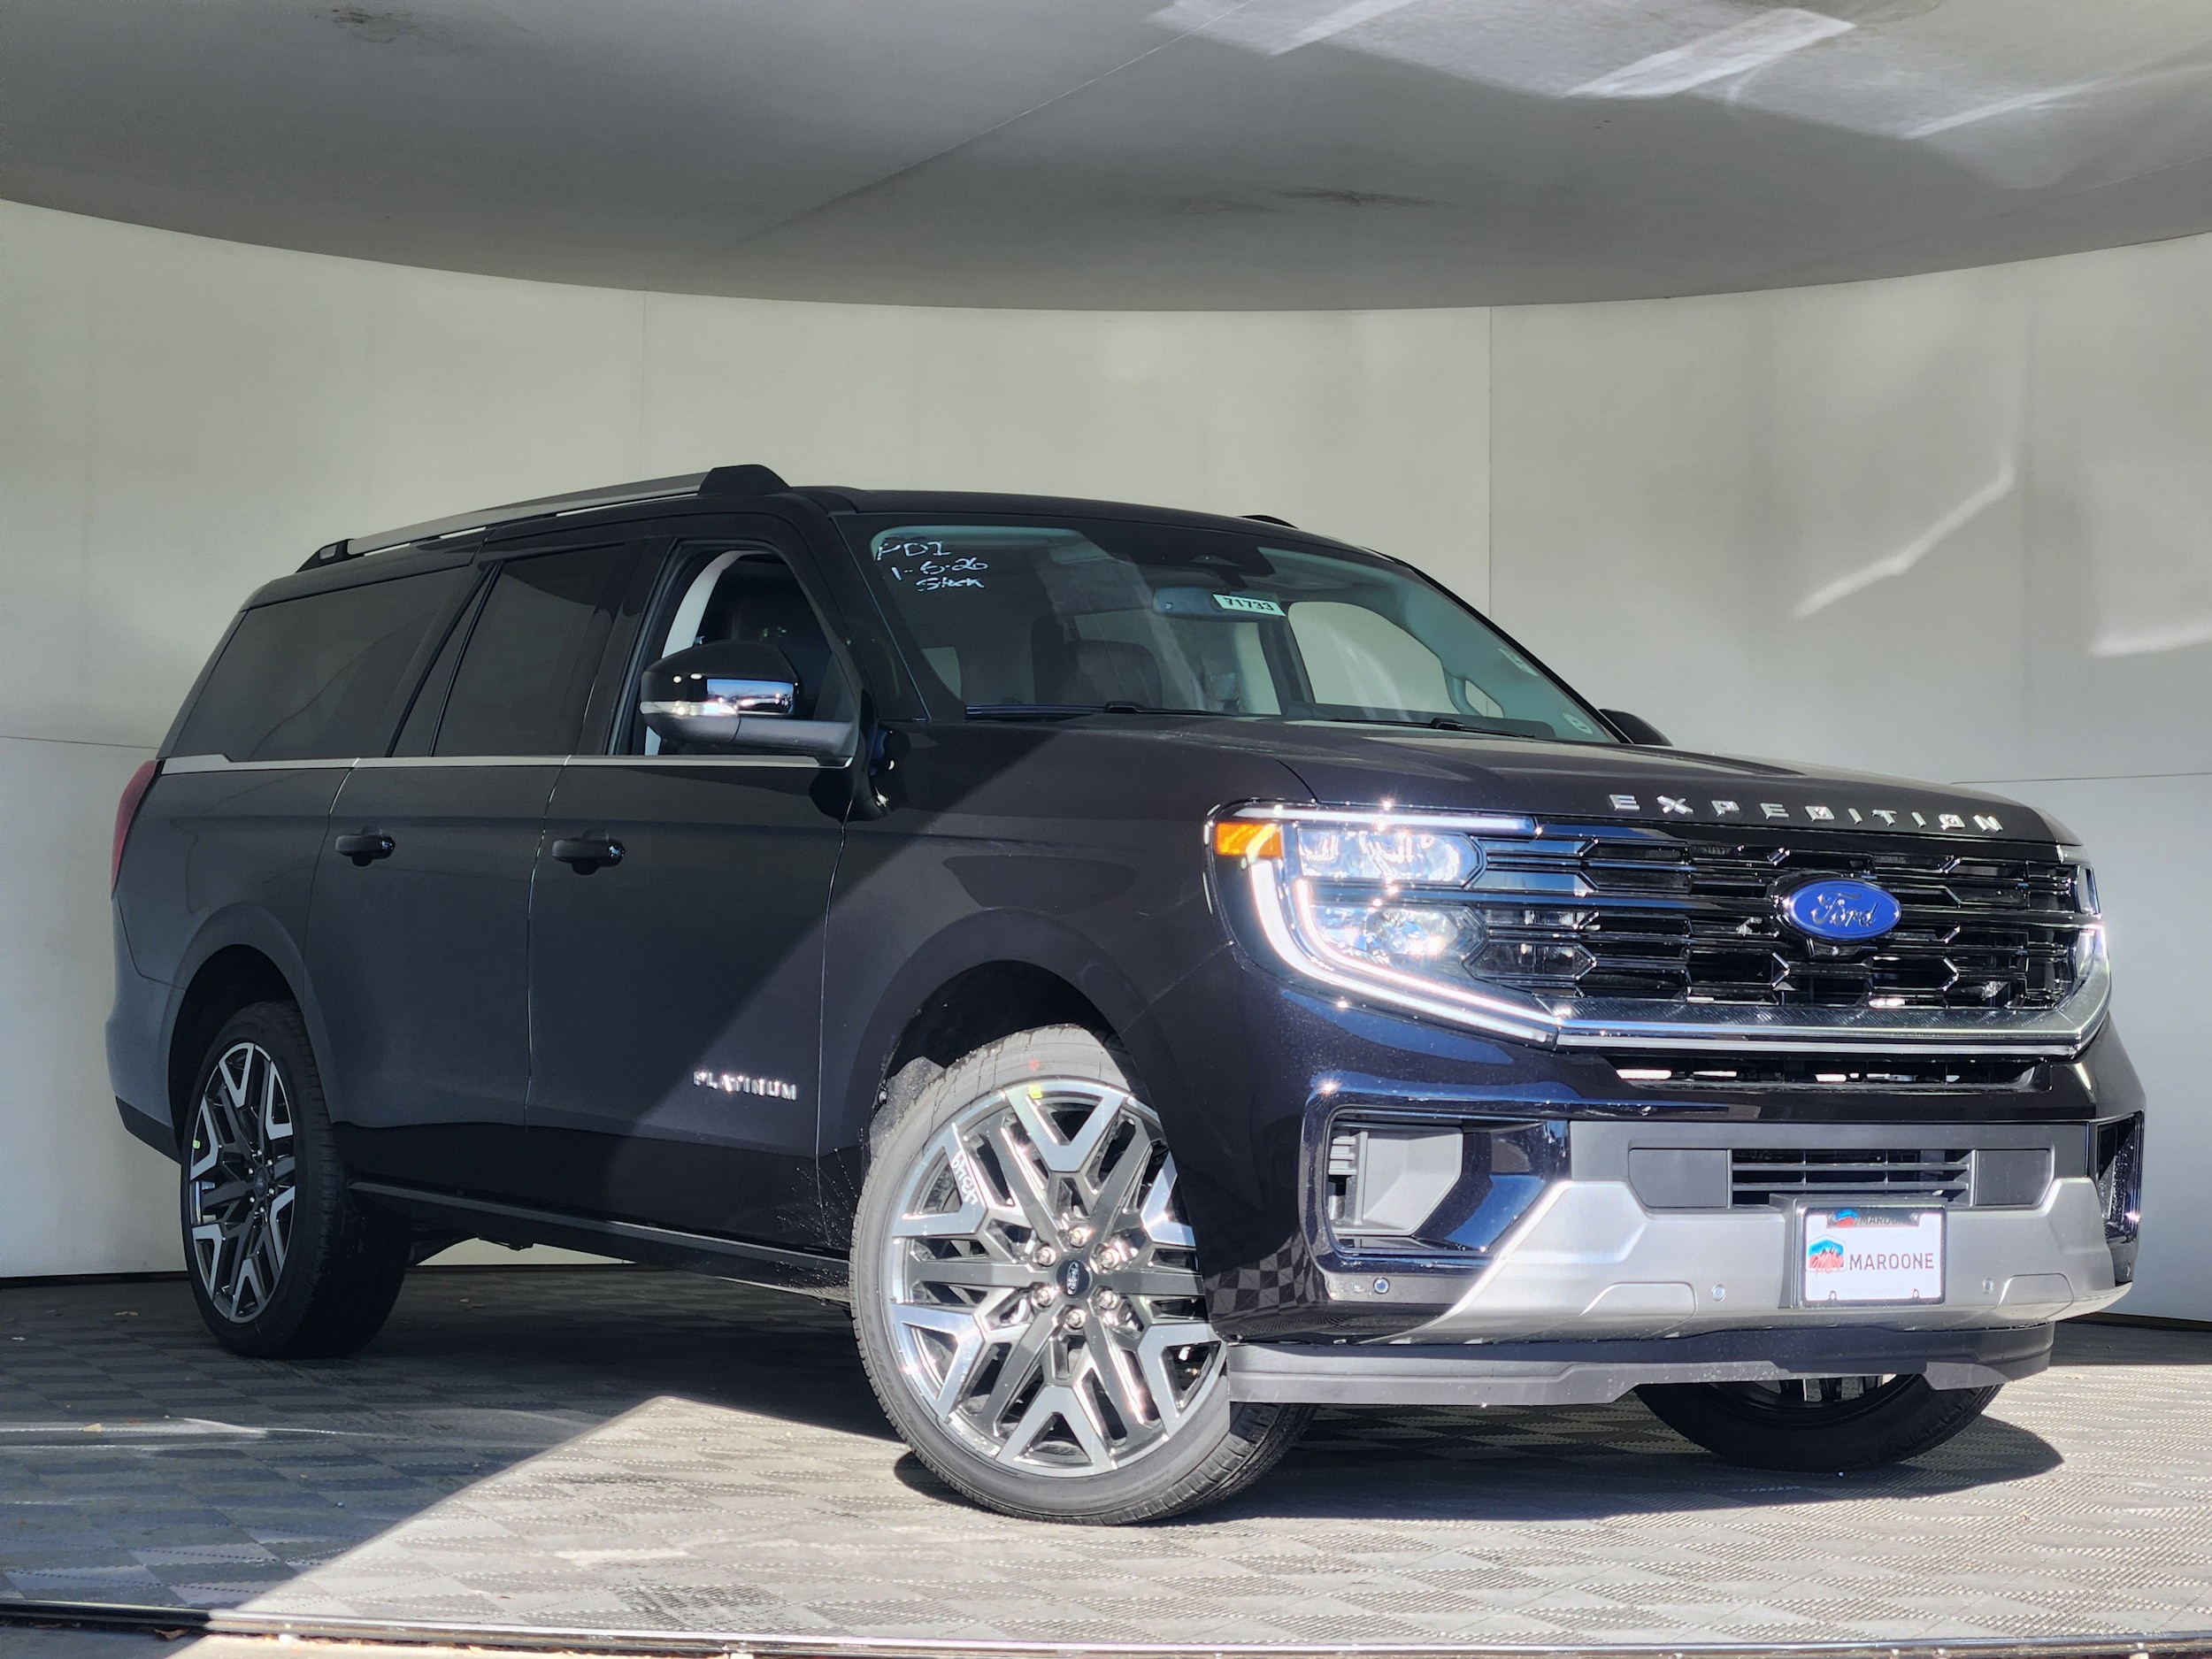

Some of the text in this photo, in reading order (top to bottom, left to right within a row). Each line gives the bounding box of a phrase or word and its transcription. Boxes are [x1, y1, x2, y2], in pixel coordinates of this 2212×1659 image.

[1223, 596, 1275, 611] 71733
[1609, 793, 2004, 833] EXPEDITION
[1810, 889, 1879, 928] Ford
[693, 1070, 797, 1102] PLATINUM
[1849, 1253, 1935, 1271] MAROONE
